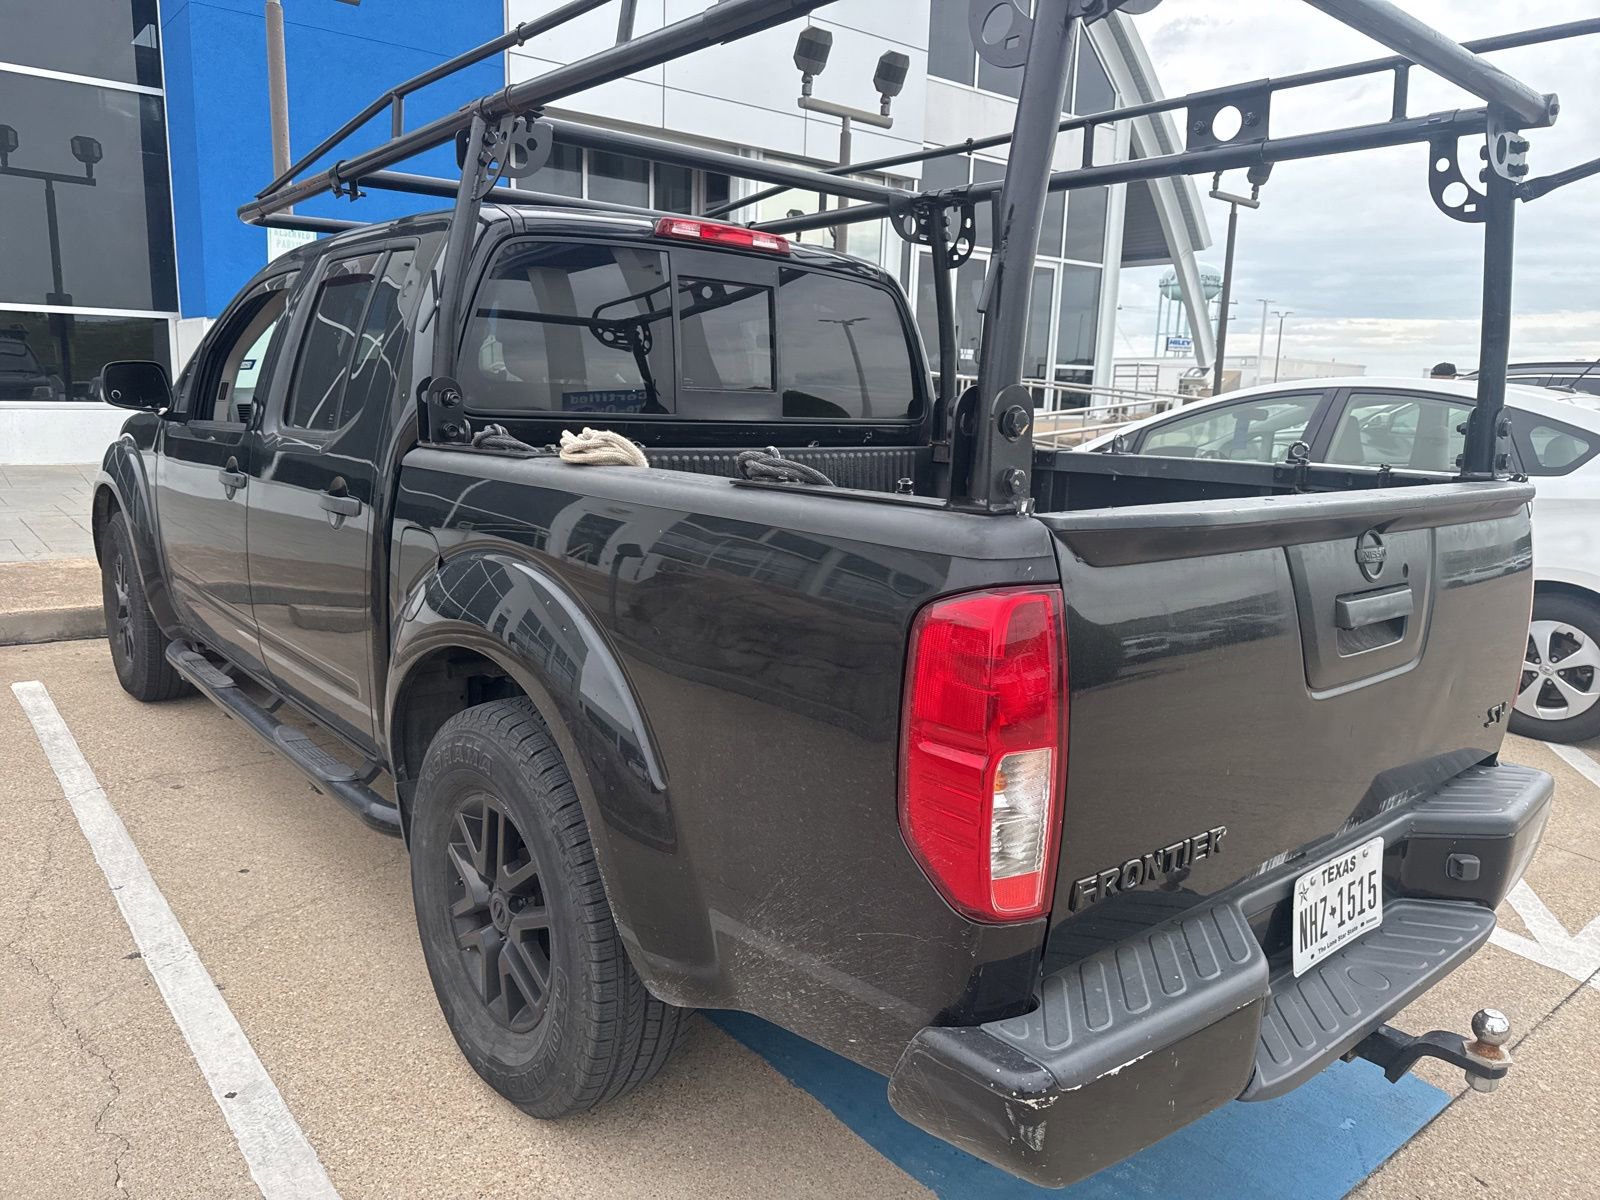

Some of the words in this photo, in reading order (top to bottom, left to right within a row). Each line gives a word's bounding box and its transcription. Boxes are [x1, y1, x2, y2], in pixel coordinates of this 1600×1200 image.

[1068, 825, 1227, 912] FRONTIER
[1321, 855, 1356, 887] TEXAS
[1318, 945, 1327, 954] The
[1327, 938, 1338, 949] Lone
[1338, 932, 1347, 942] Star
[1347, 925, 1359, 936] State
